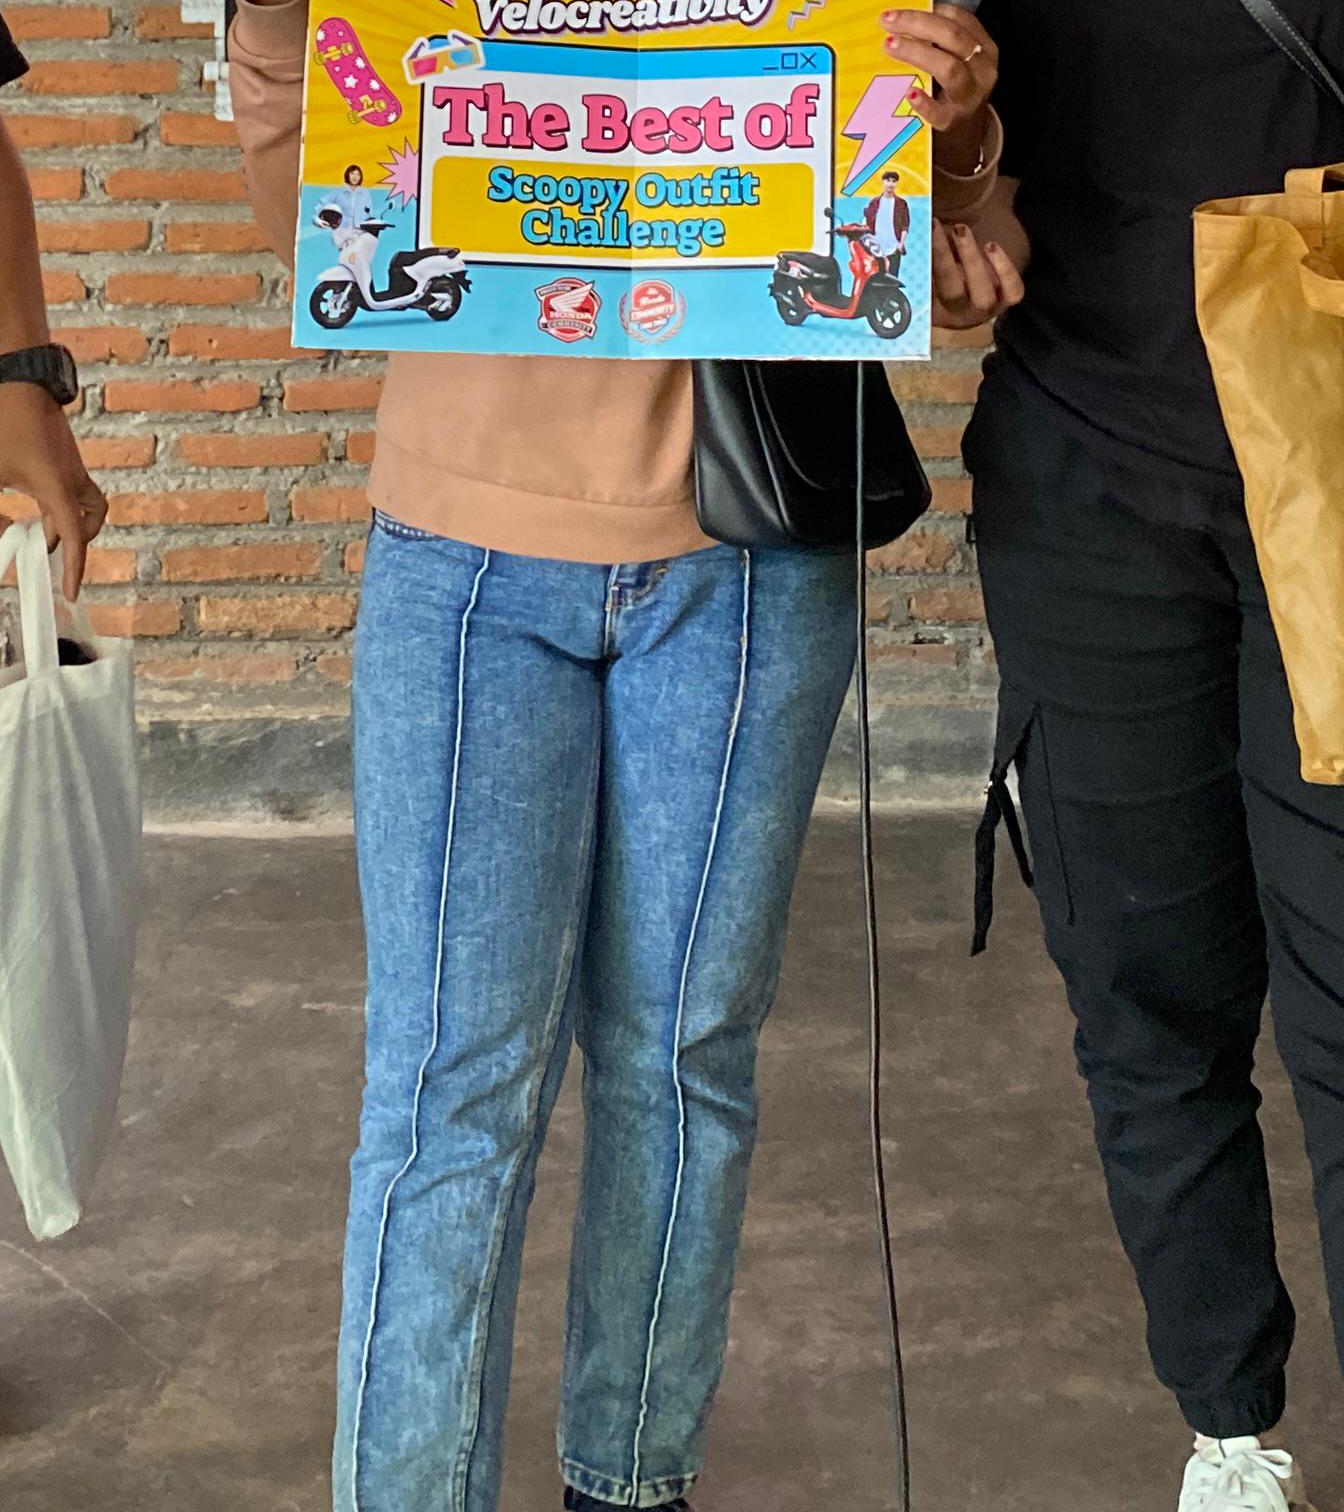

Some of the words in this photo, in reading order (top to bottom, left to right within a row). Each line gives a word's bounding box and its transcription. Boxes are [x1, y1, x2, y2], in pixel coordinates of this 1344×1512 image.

[432, 83, 571, 151] The
[581, 93, 734, 154] Best
[744, 83, 820, 151] of
[488, 165, 627, 214] Scoopy
[636, 167, 760, 207] Outfit
[521, 206, 725, 258] Challenge
[549, 311, 593, 320] HONDA
